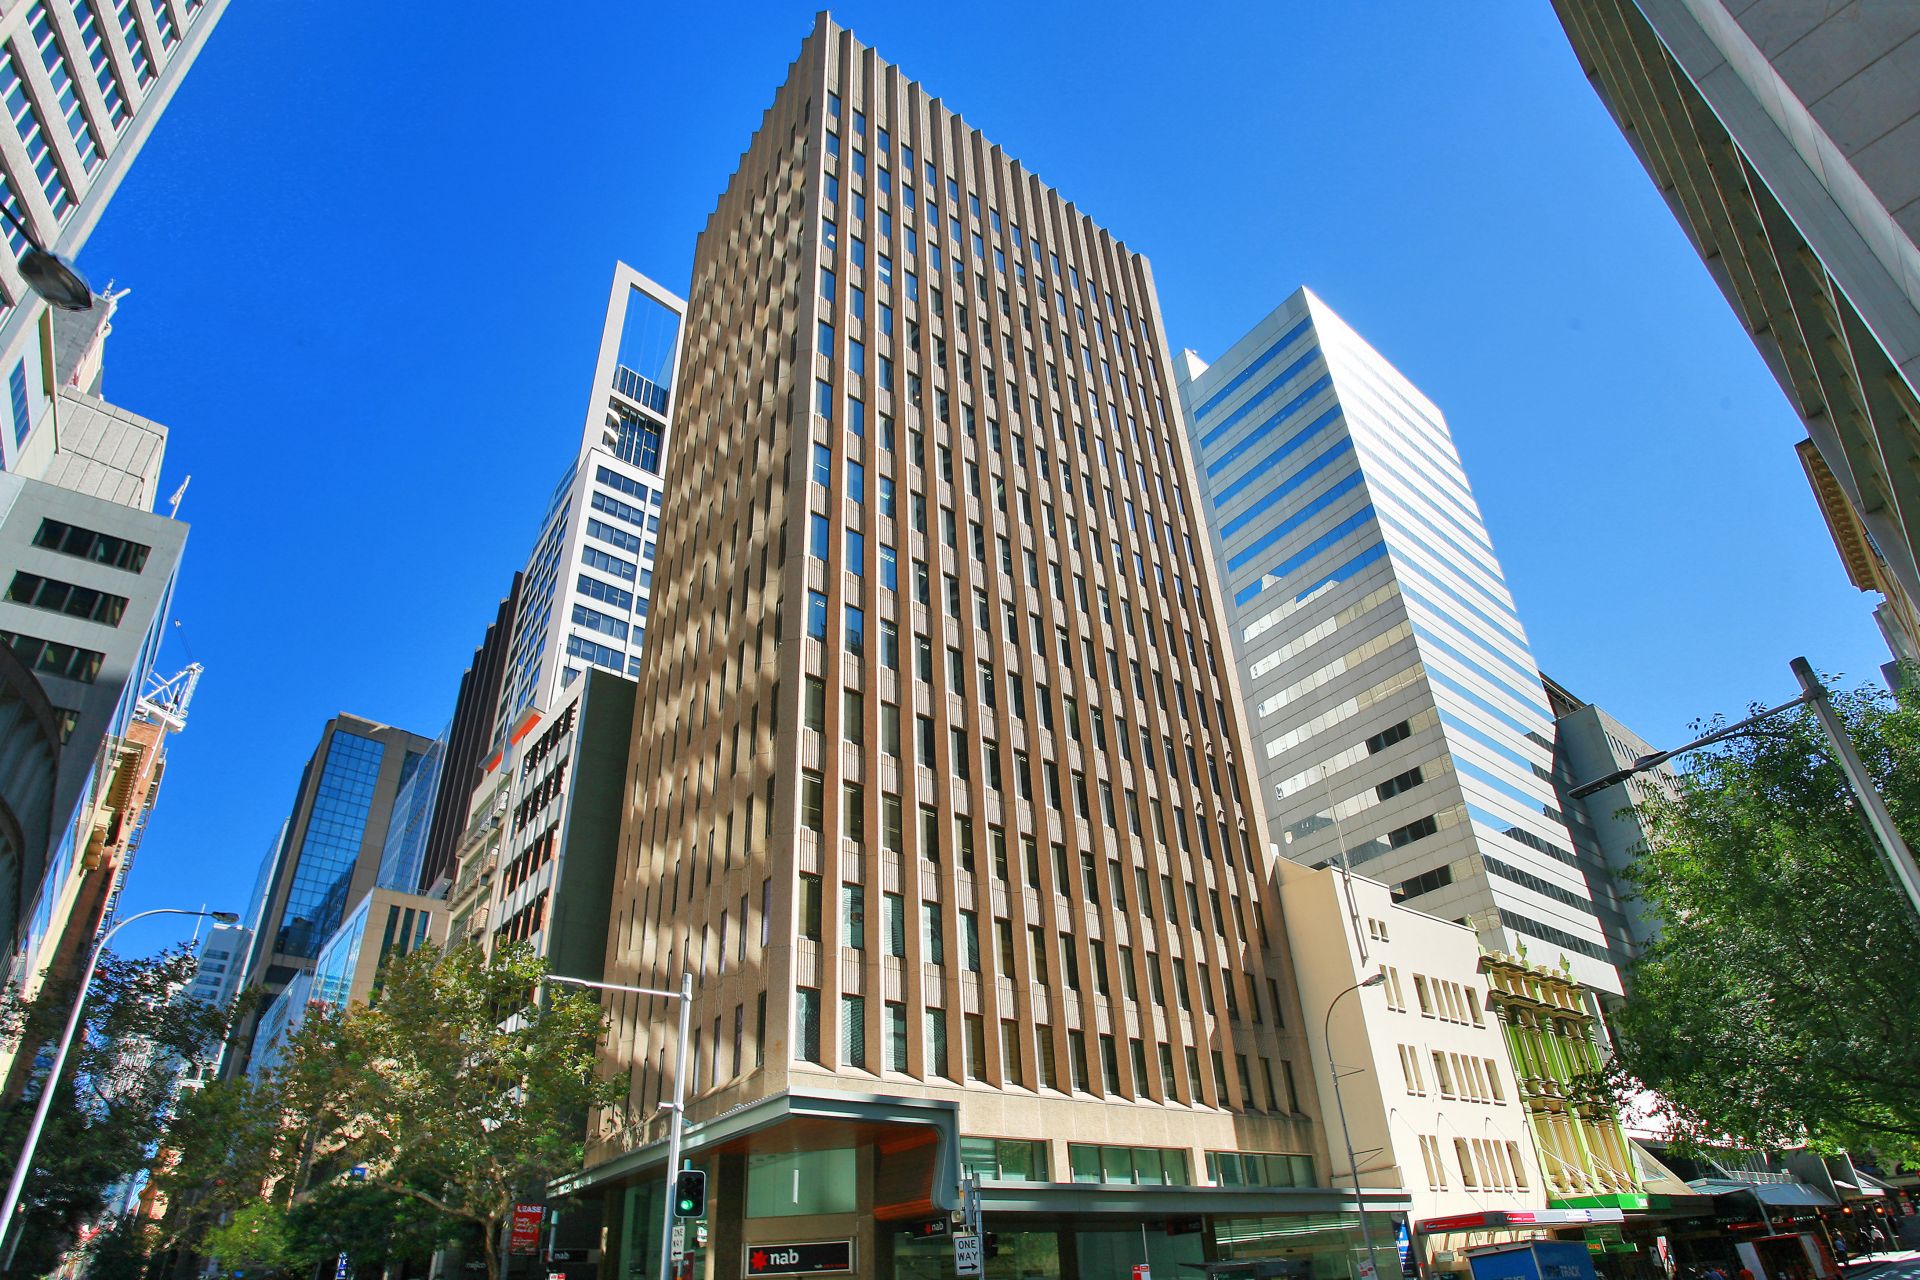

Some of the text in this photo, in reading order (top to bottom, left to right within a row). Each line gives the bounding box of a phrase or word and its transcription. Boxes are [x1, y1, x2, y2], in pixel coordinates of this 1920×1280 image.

[517, 1205, 542, 1213] LEASE
[931, 1221, 944, 1231] nab
[958, 1240, 977, 1250] ONE
[770, 1249, 800, 1265] nab
[957, 1251, 978, 1262] WAY
